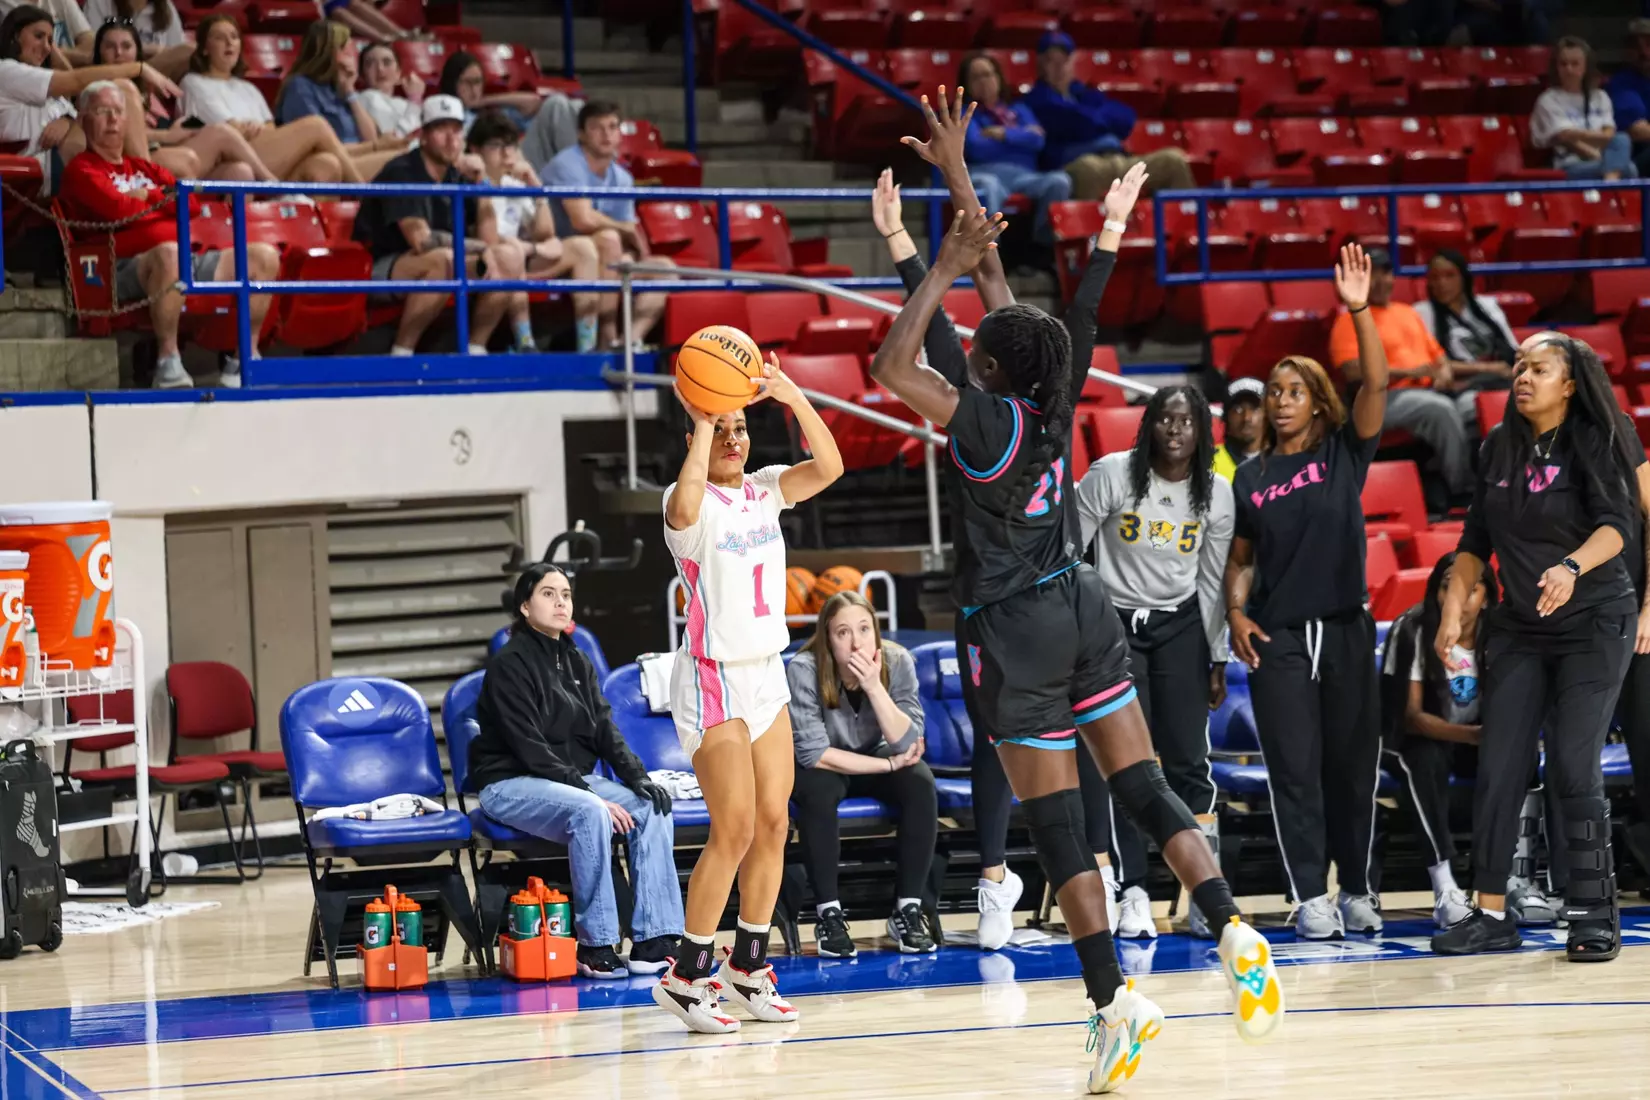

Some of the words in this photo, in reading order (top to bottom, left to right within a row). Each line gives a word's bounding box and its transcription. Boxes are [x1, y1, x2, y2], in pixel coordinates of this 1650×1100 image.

[699, 332, 752, 368] Wilson
[716, 530, 747, 557] Lady
[88, 540, 113, 592] G
[2, 590, 24, 624] G
[752, 562, 771, 618] 1
[365, 925, 379, 945] G
[547, 916, 561, 935] G
